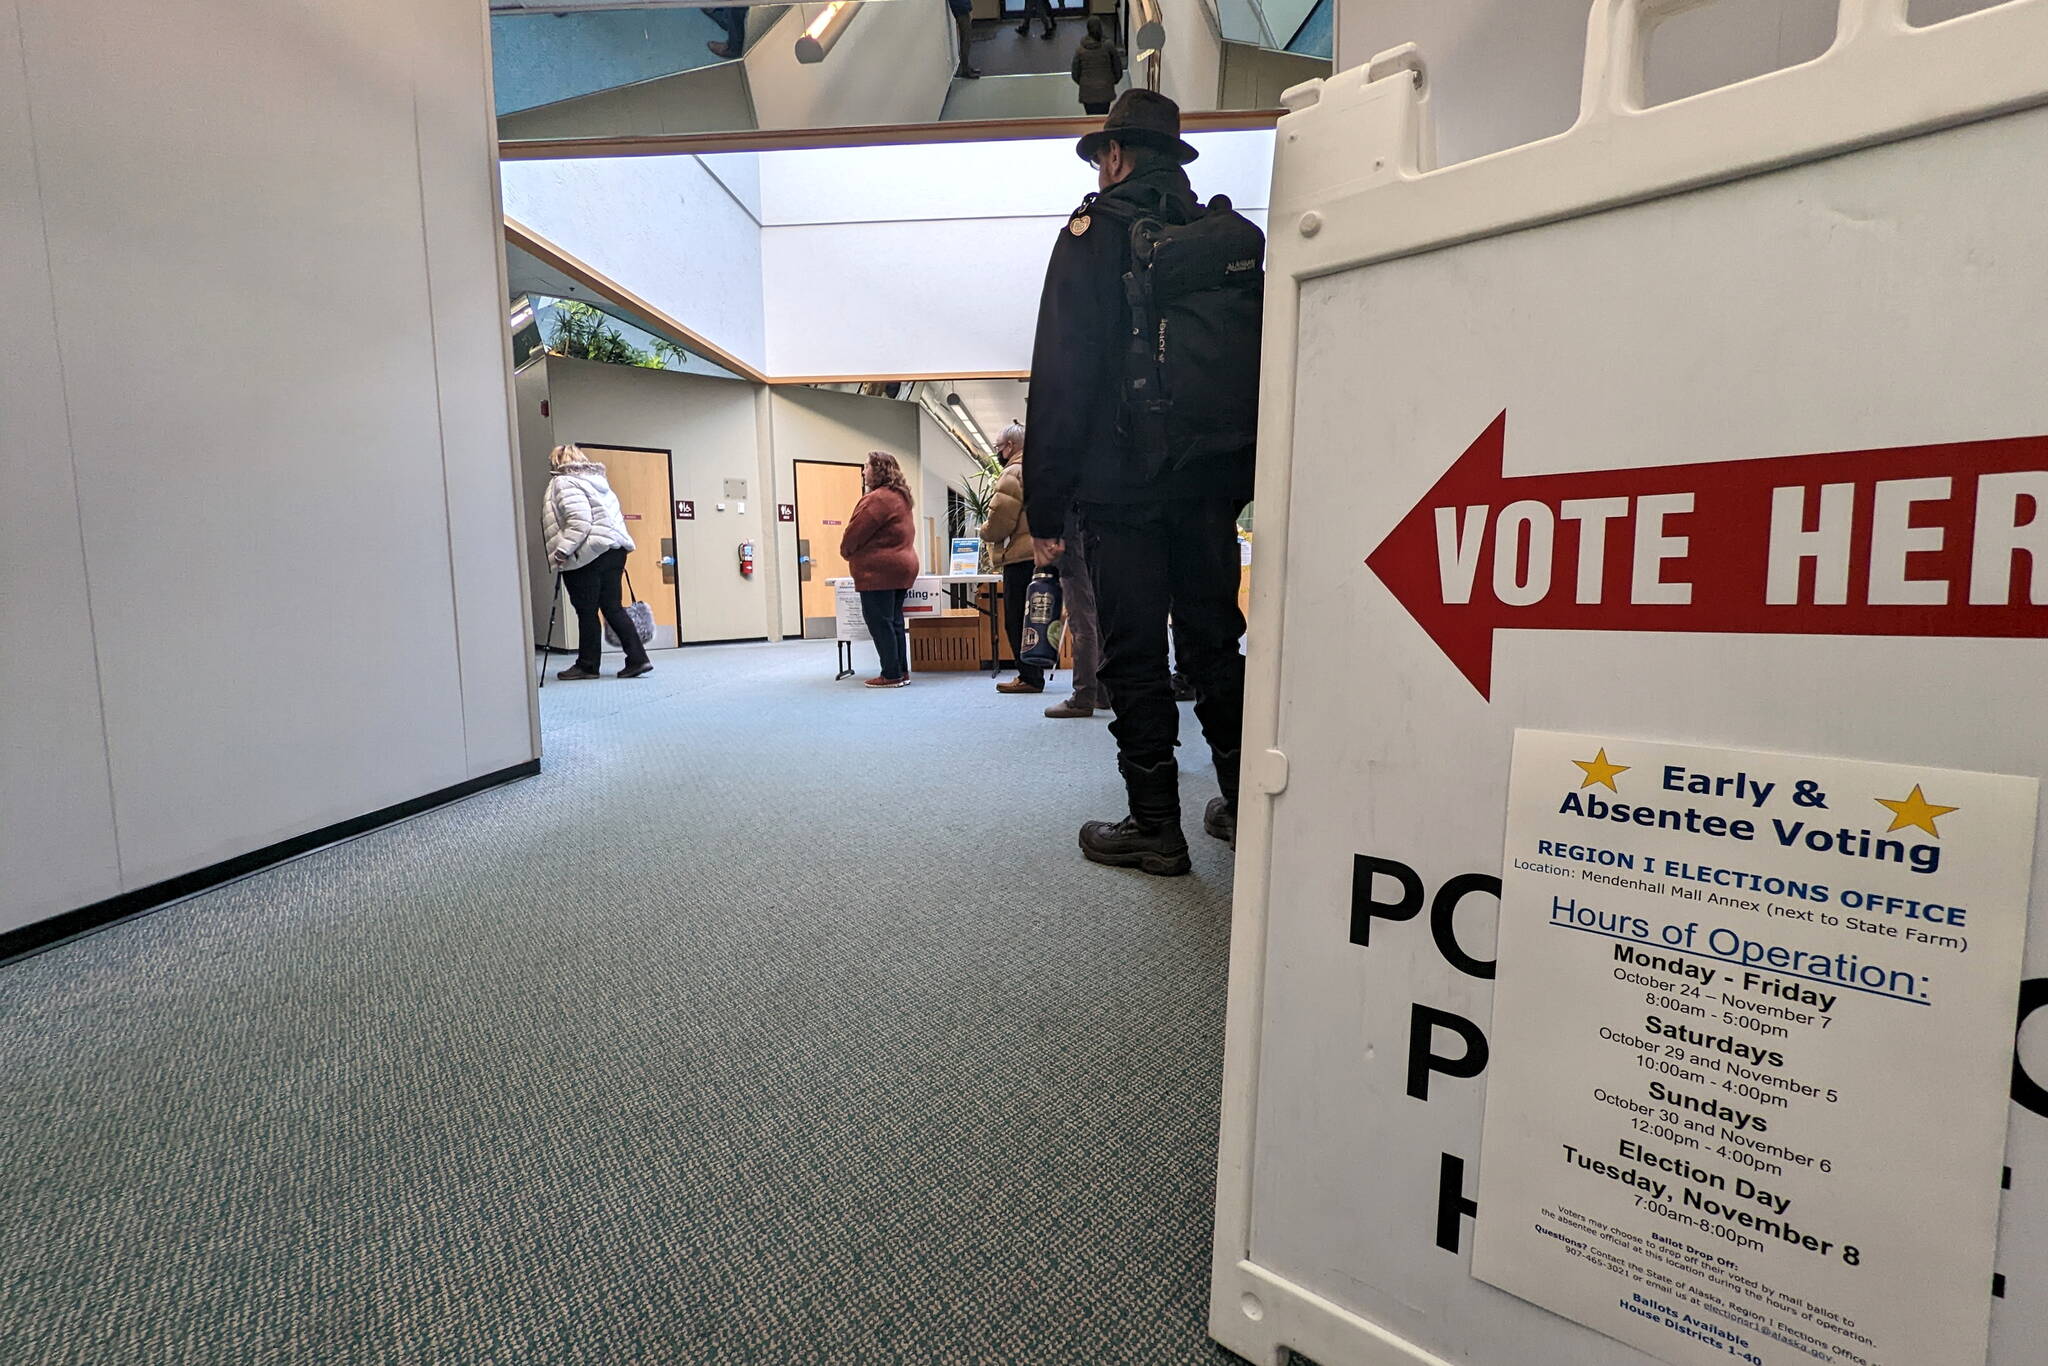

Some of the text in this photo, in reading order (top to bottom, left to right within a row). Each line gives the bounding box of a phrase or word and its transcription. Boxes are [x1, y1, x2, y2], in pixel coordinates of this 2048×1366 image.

[1434, 492, 1695, 607] VOTE
[1662, 765, 1830, 810] Early &
[1558, 791, 1941, 874] Absentee Voting
[1513, 857, 1968, 953] Location: Mendenhall Mall Annex (next to State Farm)
[1538, 839, 1967, 928] REGION I ELECTIONS OFFICE
[1552, 896, 1929, 998] Hours of Operation:
[1613, 943, 1717, 986] Monday
[1743, 971, 1837, 1013] Friday
[1612, 966, 1676, 993] October
[1679, 982, 1700, 999] 24
[1721, 992, 1815, 1026] November
[1820, 1015, 1832, 1030] 7
[1644, 991, 1705, 1018] 8:00am
[1721, 1011, 1789, 1039] 5:00pm
[1599, 1025, 1838, 1103] October 29 and November 5
[1645, 1013, 1784, 1068] Saturdays
[1635, 1053, 1705, 1084] 10:00am
[1721, 1078, 1788, 1107] 4:00pm
[1648, 1081, 1768, 1132] Sundays
[1592, 1086, 1832, 1173] October 30 and November 6
[1630, 1115, 1700, 1149] 12:00pm
[1715, 1143, 1782, 1176] 4:00pm
[1562, 1144, 1860, 1266] Tuesday, November 8
[1619, 1138, 1792, 1216] Election Day
[1633, 1193, 1764, 1253] 7:00am-8:00pm
[1650, 1231, 1738, 1270] Ballot Drop Off:
[1534, 1222, 1587, 1251] Questions?
[1589, 1245, 1625, 1266] Contact
[1627, 1260, 1642, 1273] the
[1645, 1268, 1671, 1285] State
[1674, 1281, 1685, 1291] of
[1687, 1285, 1725, 1308] Alaska,
[1728, 1302, 1765, 1323] Region
[1776, 1321, 1828, 1349] Elections
[1831, 1343, 1867, 1365] Office
[1540, 1207, 1555, 1219] the
[1557, 1215, 1597, 1236] absentee
[1599, 1232, 1629, 1249] official
[1632, 1245, 1642, 1254] at
[1644, 1248, 1663, 1262] this
[1665, 1257, 1705, 1279] location
[1707, 1273, 1741, 1295] during
[1744, 1288, 1762, 1301] the
[1765, 1296, 1798, 1315] hours
[1801, 1312, 1813, 1322] of
[1557, 1204, 1855, 1327] Voters may choose to drop off their voted by mail ballot to
[1632, 1274, 1641, 1283] or
[1645, 1280, 1672, 1295] email
[1675, 1292, 1687, 1301] us
[1689, 1298, 1700, 1307] at
[1620, 1298, 1762, 1366] House Districts 1-40
[1633, 1292, 1749, 1349] Ballots Available
